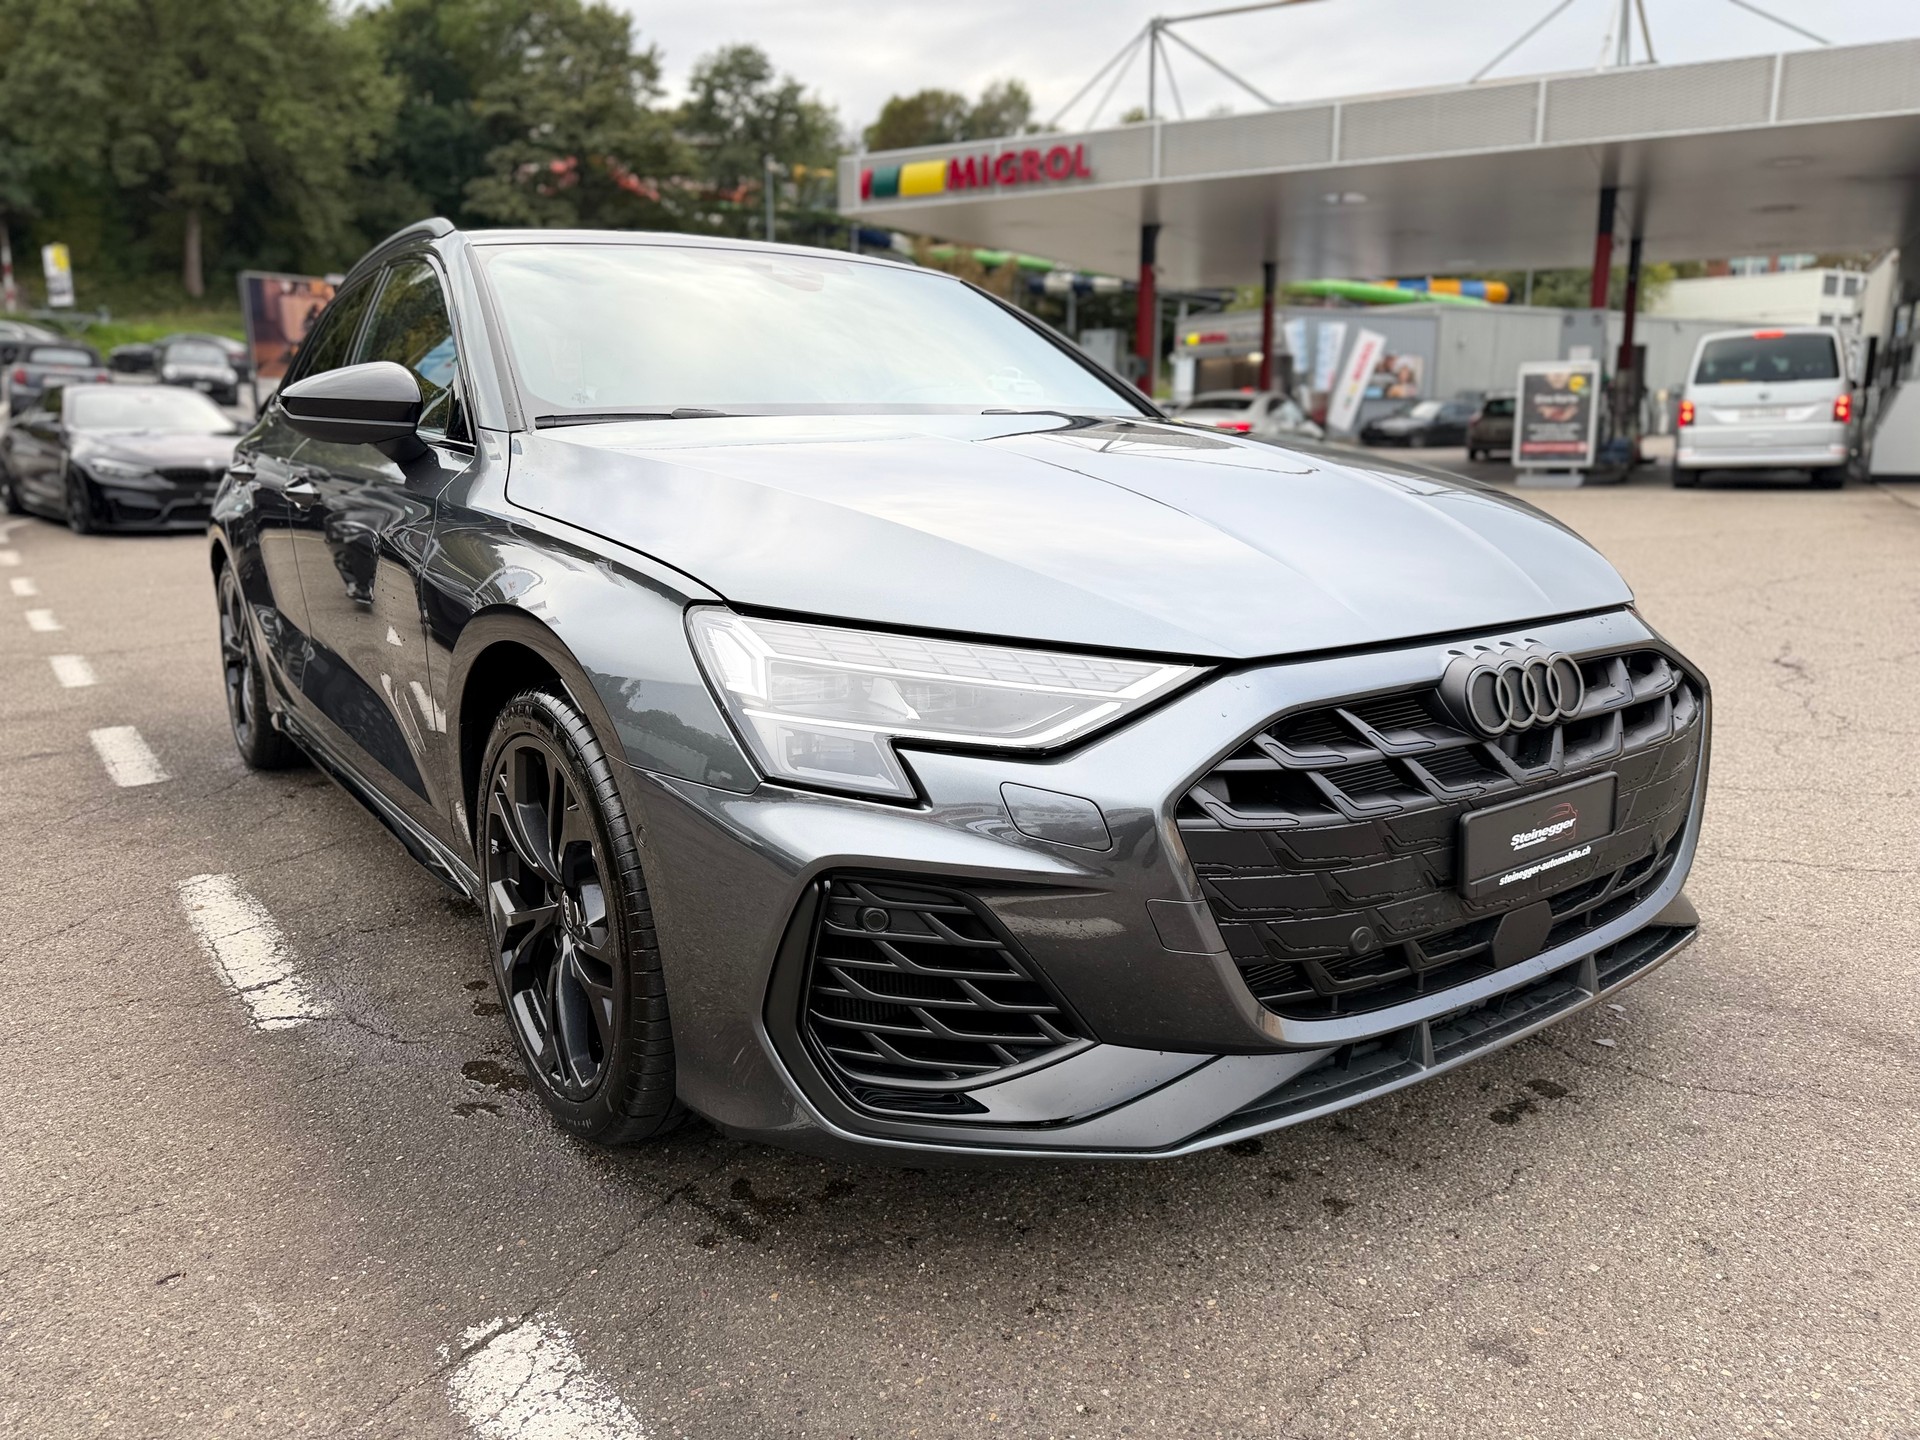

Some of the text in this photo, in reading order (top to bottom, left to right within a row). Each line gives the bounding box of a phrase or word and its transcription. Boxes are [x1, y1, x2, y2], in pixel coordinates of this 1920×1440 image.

[948, 143, 1091, 190] MIGROL
[1510, 817, 1576, 846] Steinegger
[1499, 845, 1591, 885] steinegger-automobile.ch
